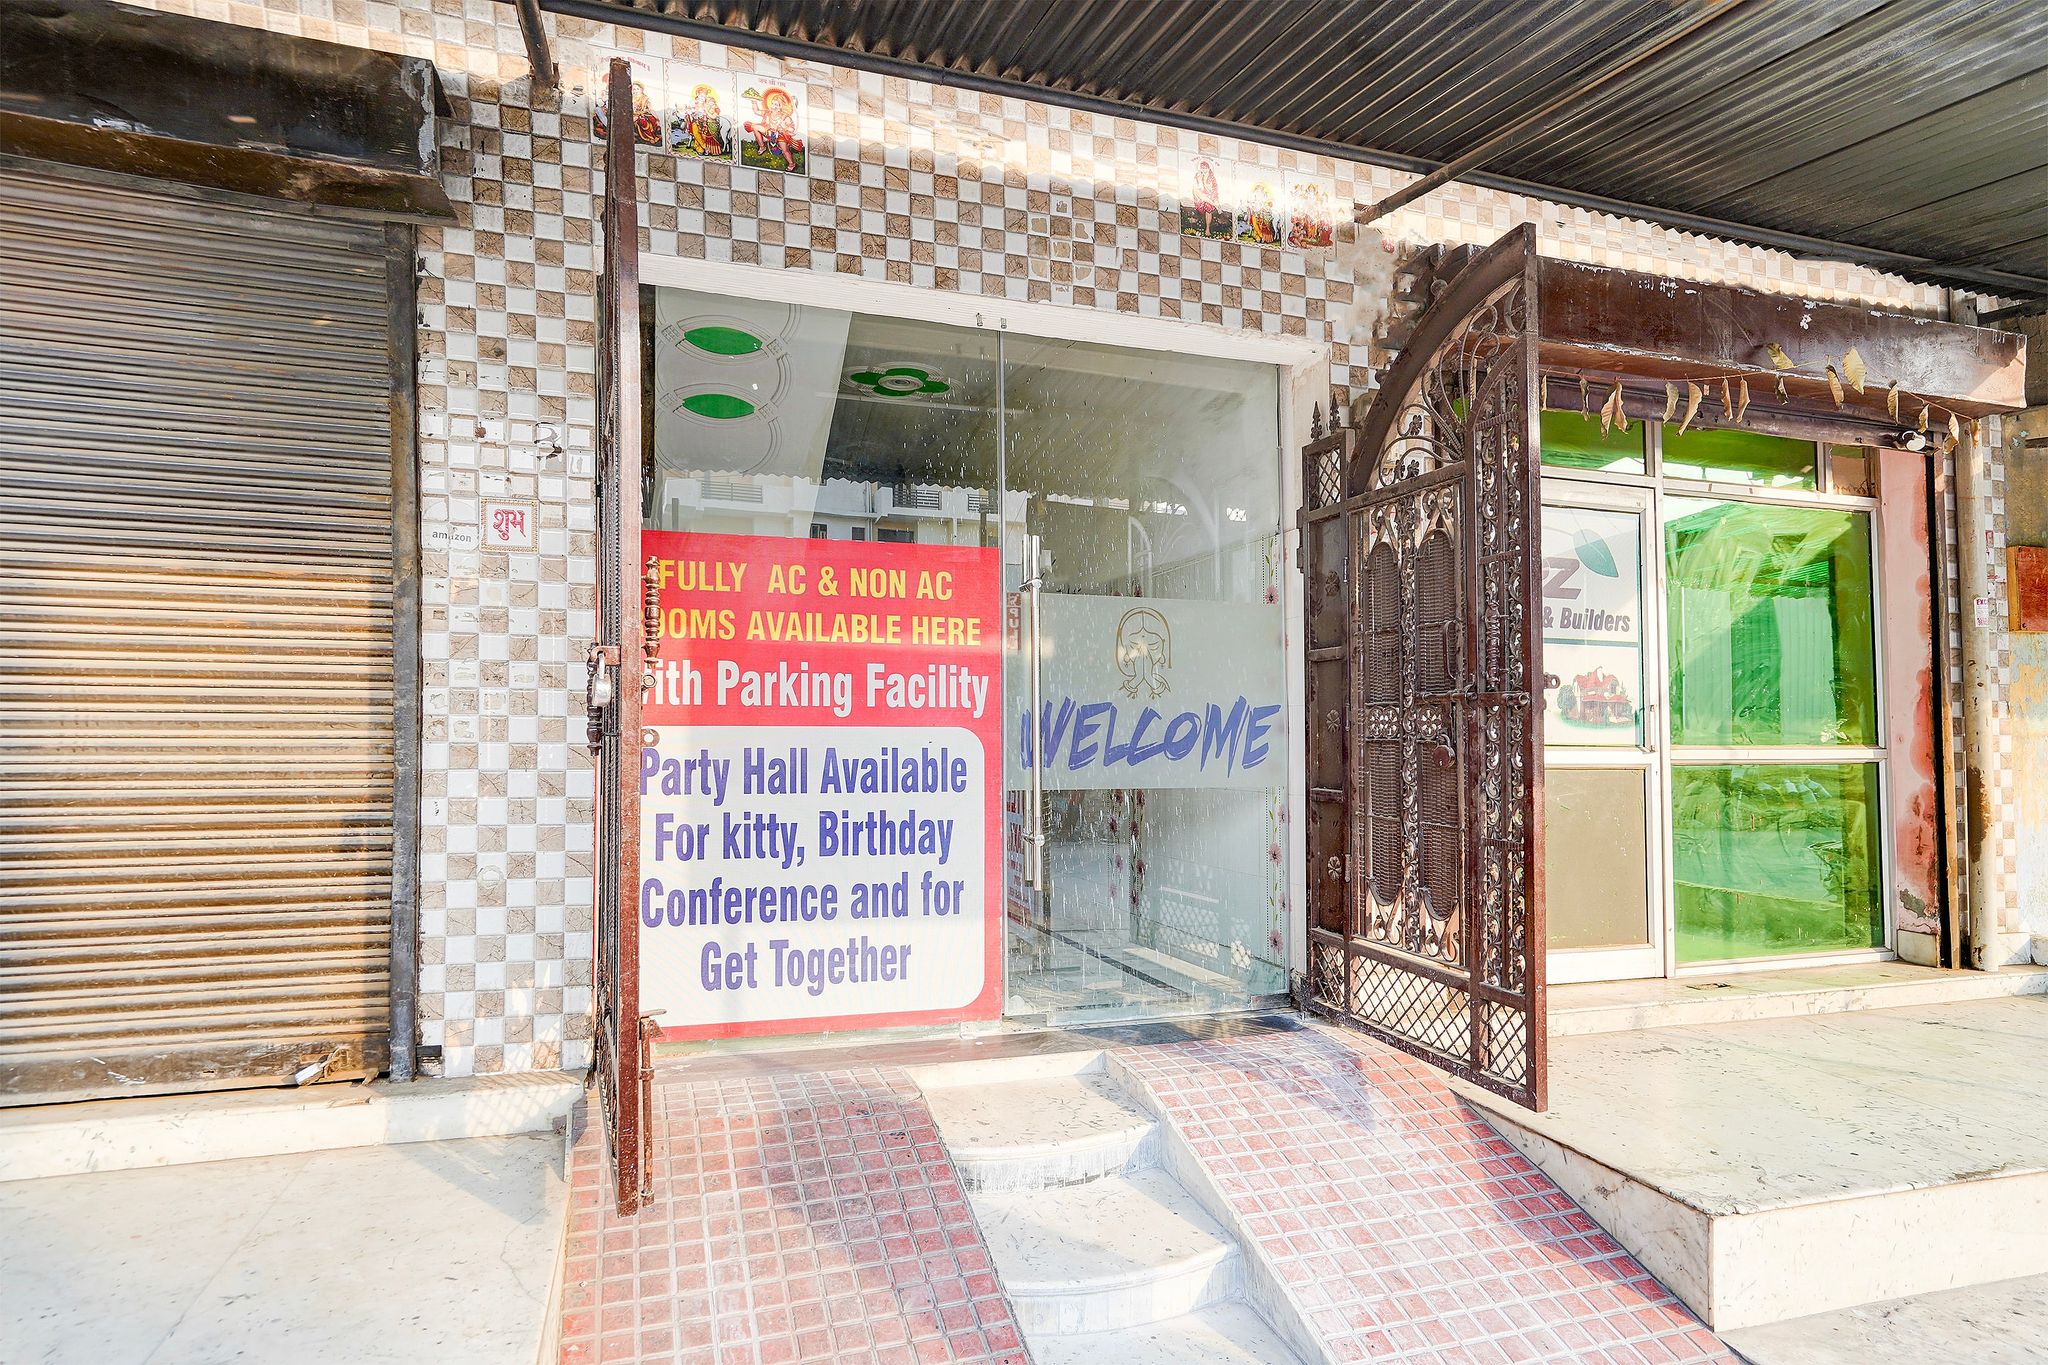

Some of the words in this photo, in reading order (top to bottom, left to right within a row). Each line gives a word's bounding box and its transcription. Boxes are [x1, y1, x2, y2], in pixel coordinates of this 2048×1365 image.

[493, 509, 527, 541] शुभ
[659, 560, 746, 592] FULLY
[768, 565, 805, 594] AC
[818, 567, 837, 595] &
[851, 568, 905, 598] NON
[917, 571, 952, 600] AC
[1543, 557, 1581, 600] Z
[640, 608, 735, 640] OMS
[747, 612, 900, 644] AVAILABLE
[912, 616, 980, 645] HERE
[1560, 607, 1631, 632] Builders
[718, 661, 851, 717] Parking
[867, 664, 988, 718] Facility
[1020, 696, 1281, 778] WELCOME
[641, 748, 729, 806] Party
[743, 747, 808, 794] Hall
[821, 747, 967, 795] Available
[656, 814, 710, 861] For
[723, 811, 805, 869] kitty,
[819, 809, 953, 865] Birthday
[642, 877, 838, 928] Conference
[851, 871, 908, 918] and
[921, 871, 965, 916] for
[701, 941, 756, 991] Get
[769, 936, 911, 995] Together
